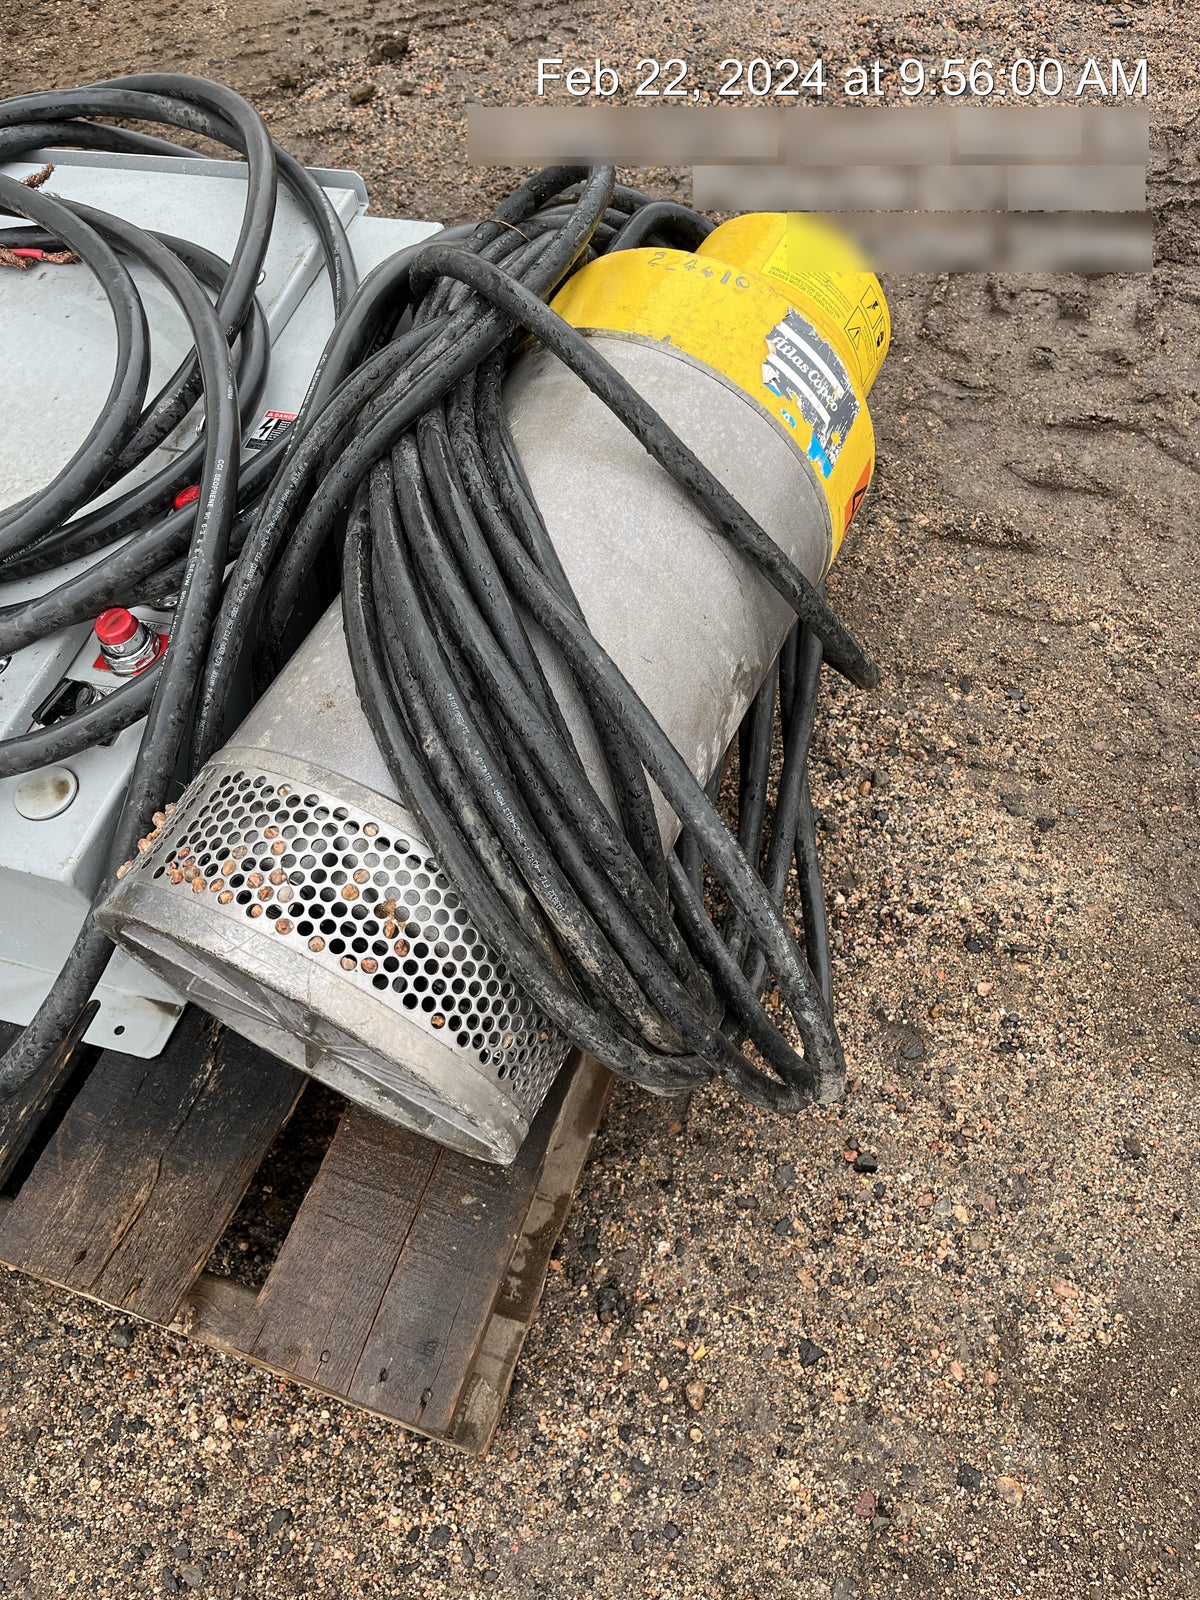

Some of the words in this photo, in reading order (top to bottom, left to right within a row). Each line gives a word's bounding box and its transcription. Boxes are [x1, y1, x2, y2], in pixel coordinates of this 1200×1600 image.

[789, 274, 815, 293] DIRECTION
[821, 296, 841, 318] ROTATION
[772, 335, 809, 374] Atlas
[274, 412, 297, 420] DANG
[216, 458, 225, 470] CCI
[206, 472, 221, 509] SEOPRENE
[253, 551, 262, 562] FT2
[184, 562, 195, 586] SEOW
[492, 789, 506, 806] MSHA
[538, 874, 551, 889] FT2
